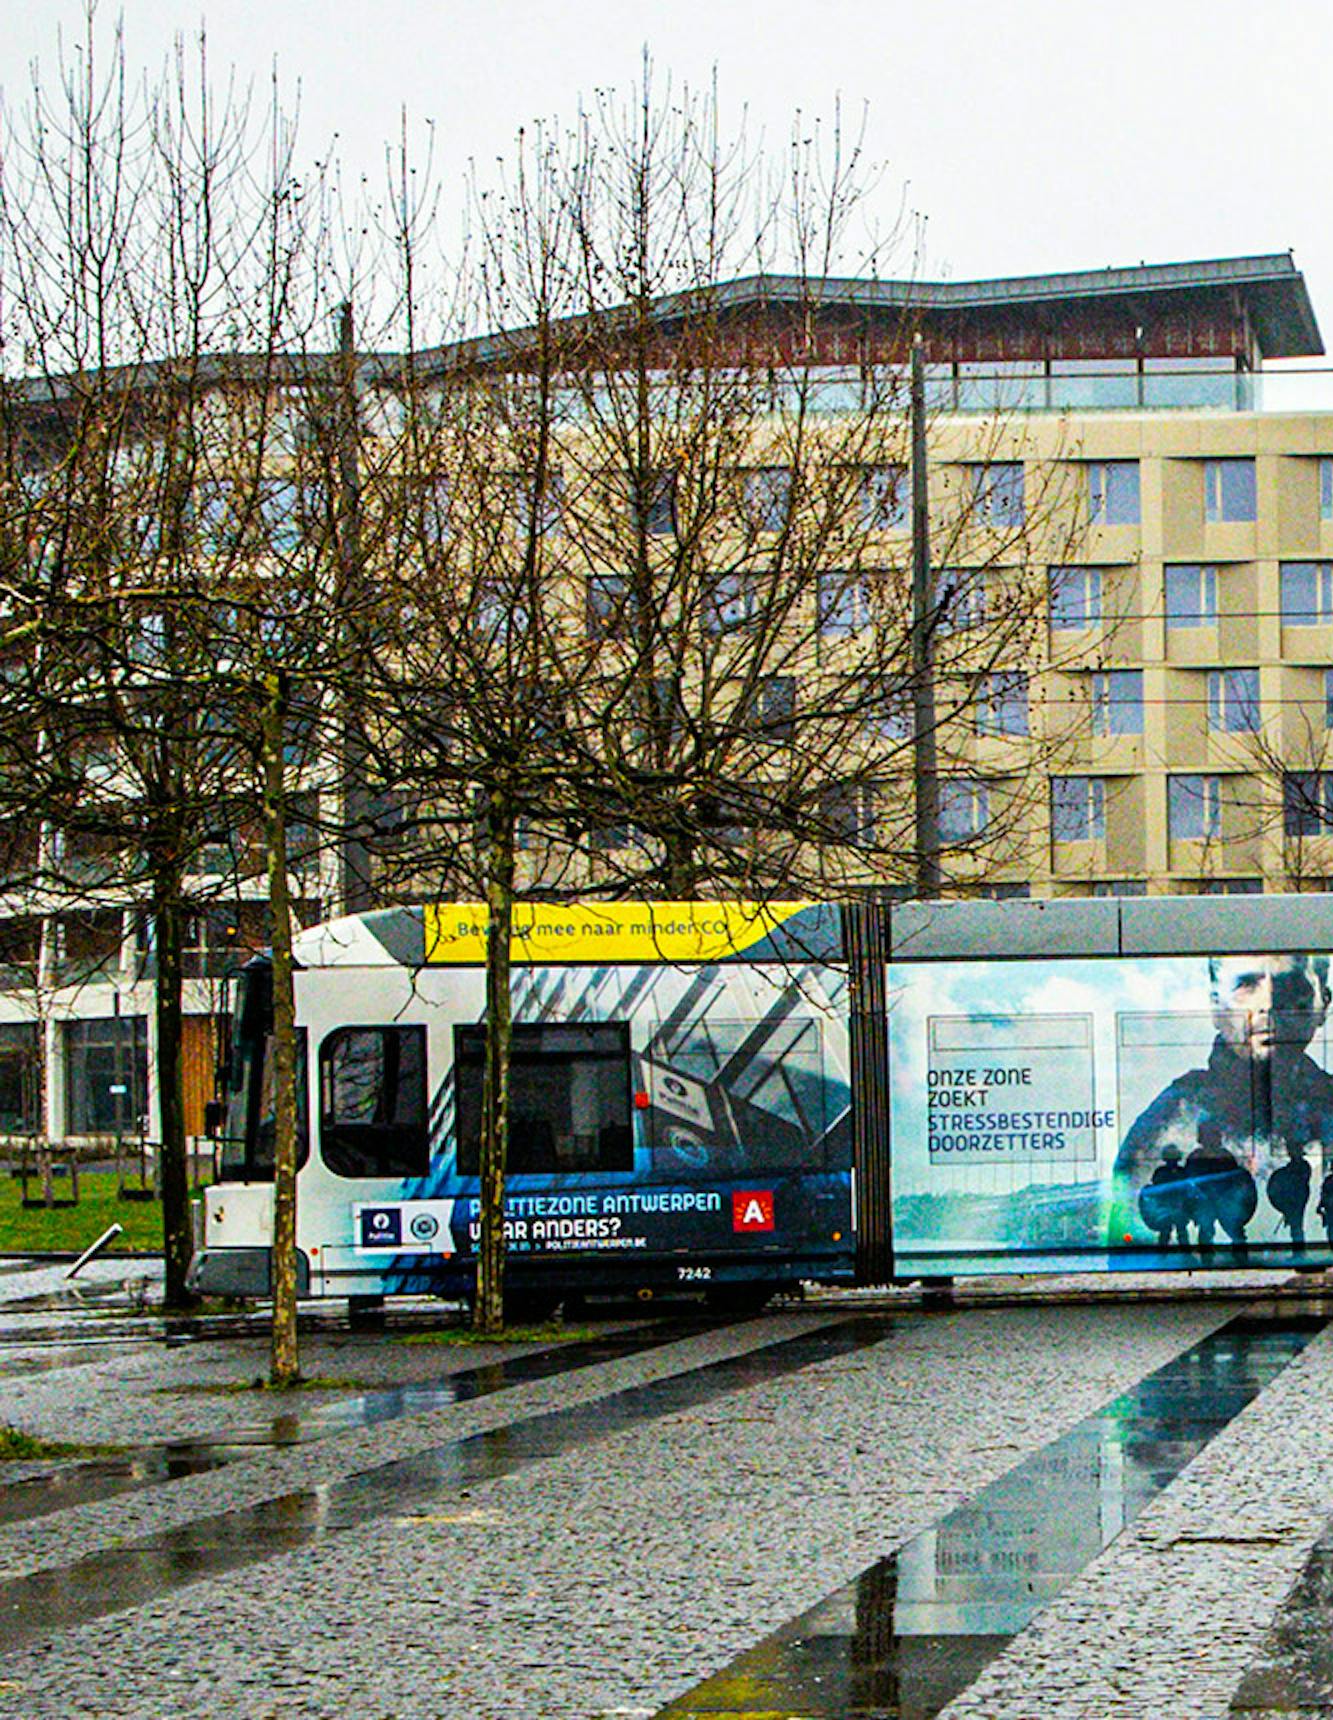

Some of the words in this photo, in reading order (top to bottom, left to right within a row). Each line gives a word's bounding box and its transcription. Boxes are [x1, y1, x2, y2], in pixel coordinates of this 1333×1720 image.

[537, 923, 575, 937] mee
[582, 921, 622, 937] naar
[928, 1069, 977, 1087] ONZE
[983, 1068, 1032, 1086] ZONE
[928, 1090, 988, 1108] ZOEKT
[928, 1110, 1115, 1132] STRESSBESTENDIGE
[928, 1132, 1066, 1152] DOORZETTERS
[468, 1195, 598, 1218] PITIEZONE
[602, 1192, 722, 1213] ANTWERPEN
[468, 1220, 528, 1241] WAR
[532, 1217, 622, 1238] ANDERS?
[677, 1267, 712, 1279] 7242
